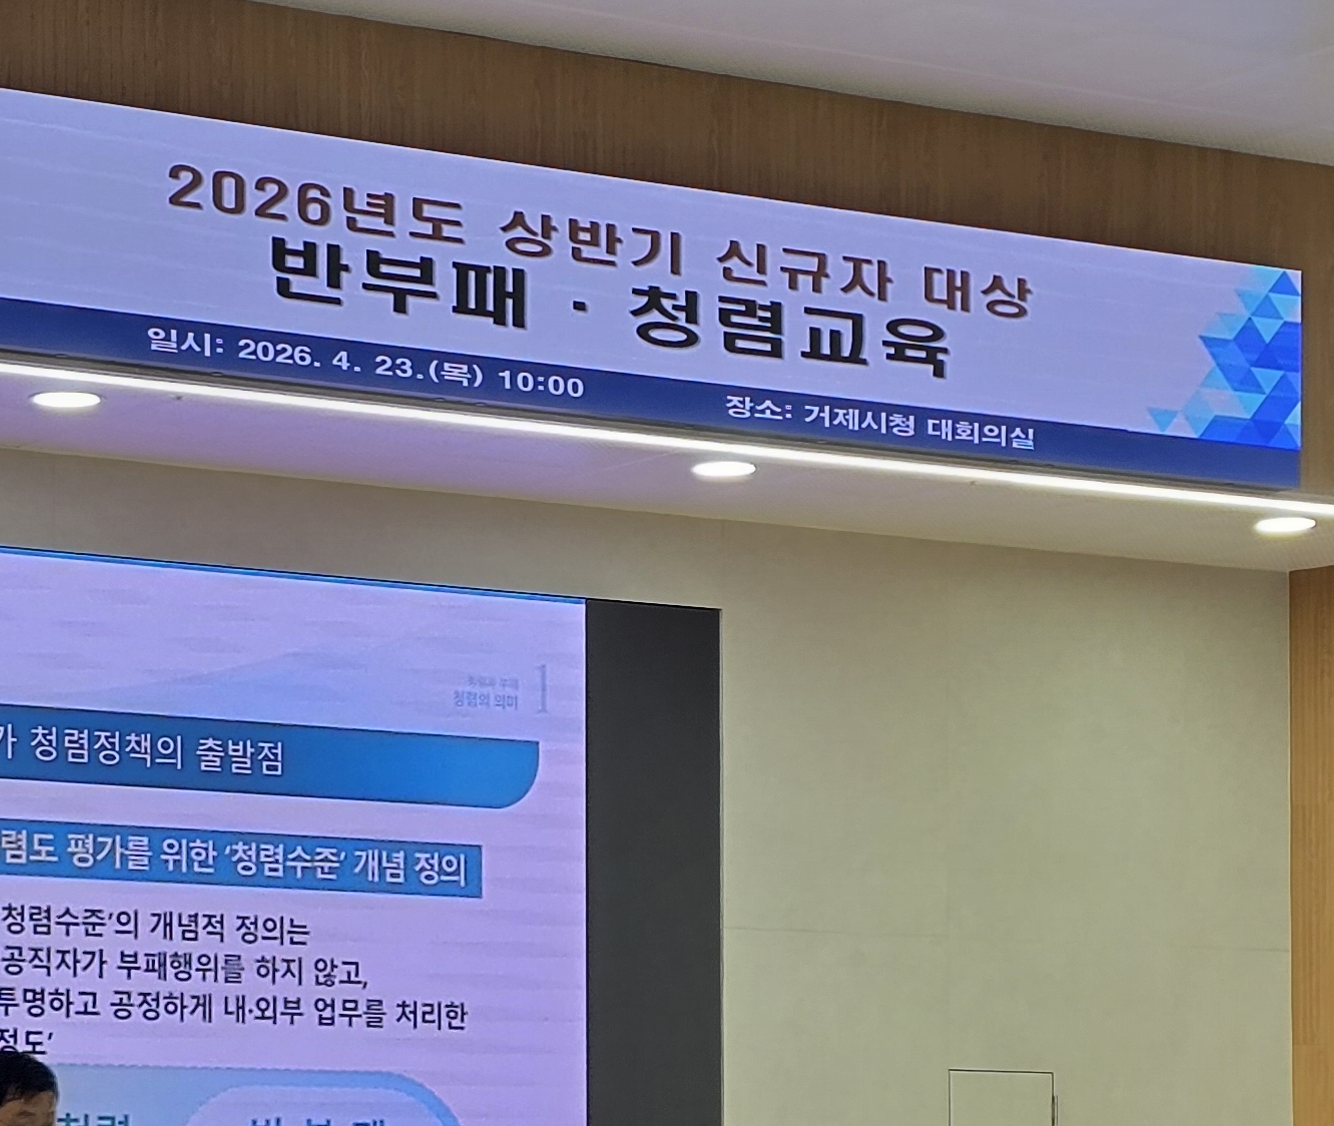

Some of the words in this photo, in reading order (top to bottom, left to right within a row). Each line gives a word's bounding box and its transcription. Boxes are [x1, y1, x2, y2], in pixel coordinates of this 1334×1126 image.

[167, 163, 466, 244] 2026년도
[500, 208, 685, 277] 상반기
[717, 238, 892, 304] 신규자
[923, 263, 1034, 319] 대상
[270, 234, 530, 332] 반부패
[628, 283, 951, 379] 청렴교육
[147, 327, 224, 358] 일시:
[237, 338, 321, 368] 2026.
[332, 350, 362, 374] 4.
[375, 354, 484, 388] 23.(목)
[499, 368, 584, 398] 10:00
[725, 395, 792, 420] 장소:
[804, 404, 916, 437] 거제시청
[927, 417, 1036, 451] 대회의실
[30, 726, 183, 770] 청렴정책의
[195, 738, 283, 776] 출발점
[67, 833, 153, 871] 평가를
[160, 838, 217, 873] 위한
[224, 841, 346, 879] ‘청렴수준’
[354, 849, 405, 884] 개념
[414, 851, 466, 888] 정의
[150, 911, 224, 943] 개념적
[236, 915, 311, 946] 정의는
[116, 951, 244, 984] 부패행위를
[255, 955, 303, 986] 하지
[314, 958, 368, 990] 않고,
[110, 990, 213, 1024] 공정하게
[224, 994, 304, 1026] 내·외부
[314, 998, 387, 1029] 업무를
[396, 1000, 469, 1031] 처리한
